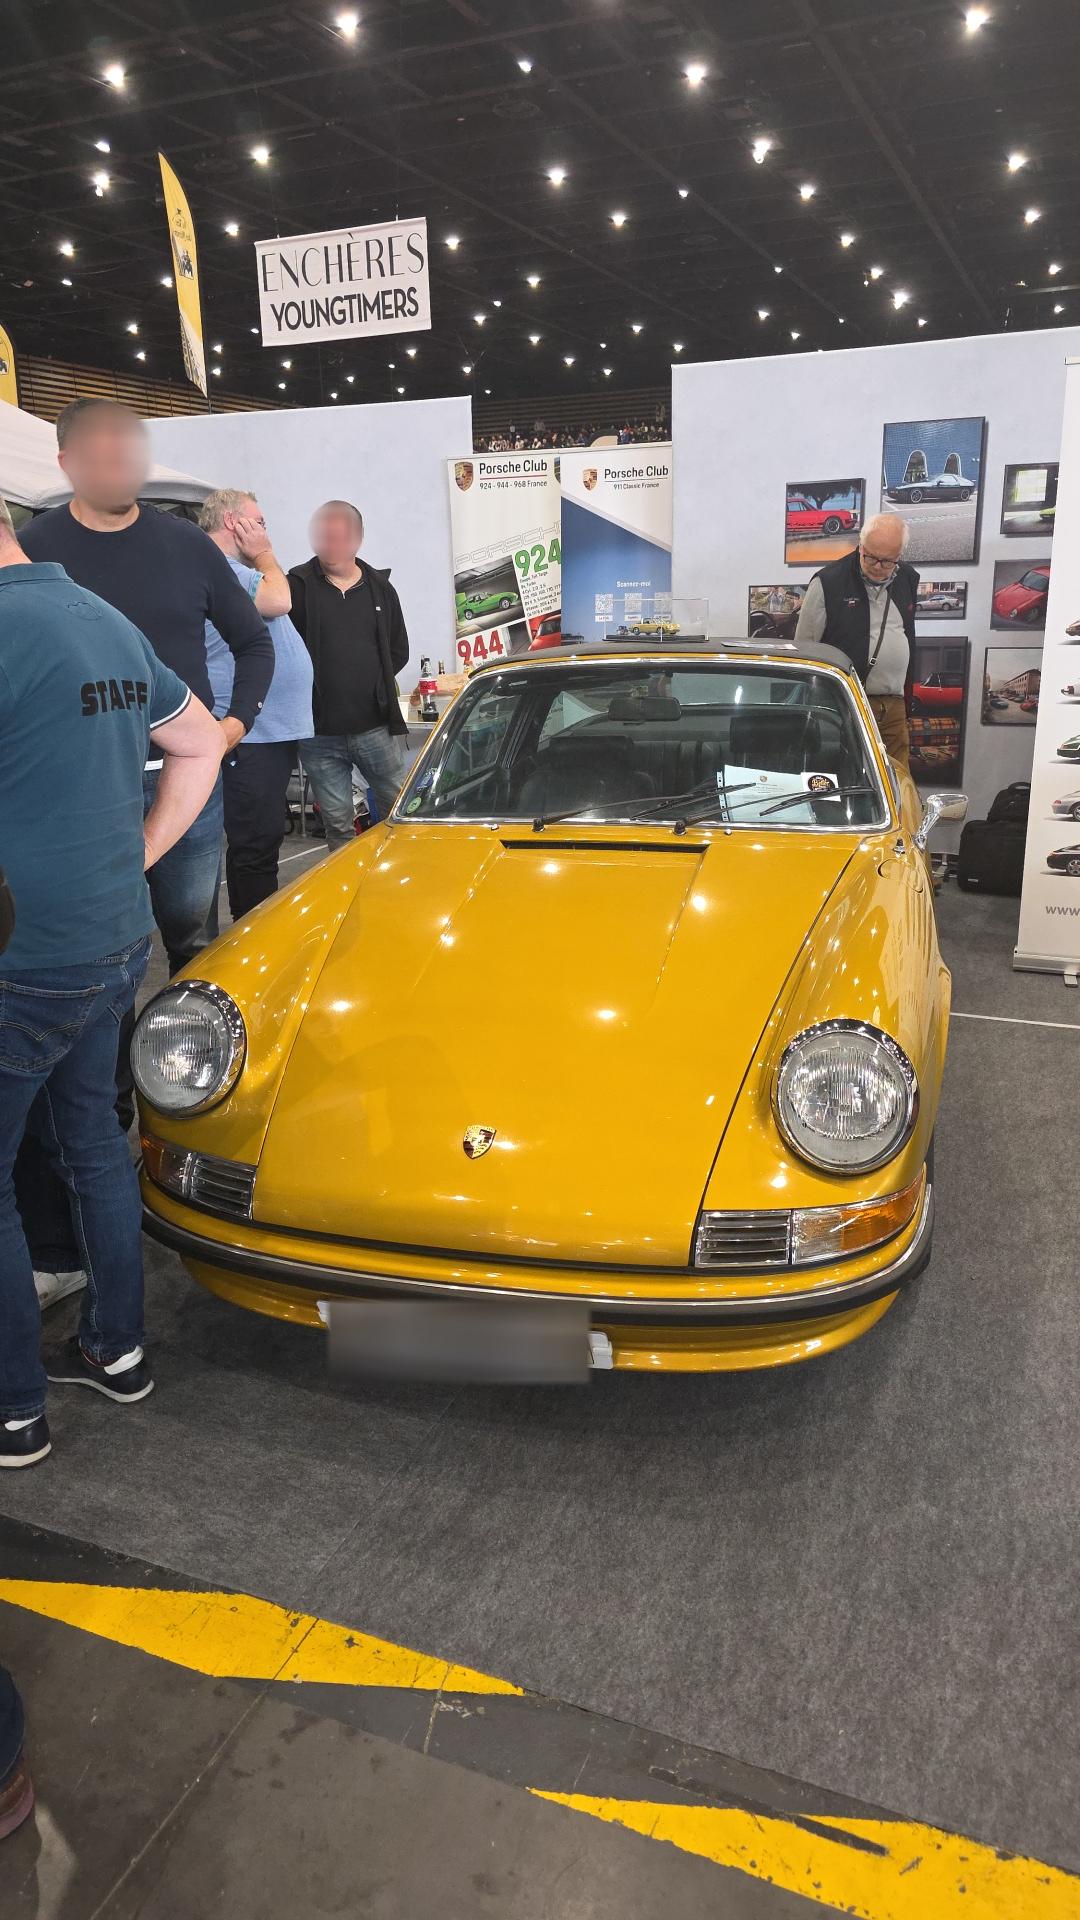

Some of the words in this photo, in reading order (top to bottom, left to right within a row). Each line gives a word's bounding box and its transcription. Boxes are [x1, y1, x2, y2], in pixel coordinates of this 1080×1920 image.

[261, 232, 425, 292] ENCHÈRES
[270, 286, 419, 332] YOUNGTIMERS
[479, 461, 521, 475] Porsche
[523, 459, 548, 472] Club
[479, 482, 492, 490] 924
[497, 481, 509, 489] 944
[513, 480, 527, 488] 968
[528, 479, 548, 487] France
[604, 467, 644, 479] Porsche
[646, 465, 669, 477] Club
[623, 482, 641, 490] Classic
[514, 537, 561, 578] 924
[457, 630, 504, 666] 944
[80, 679, 148, 717] STAFF
